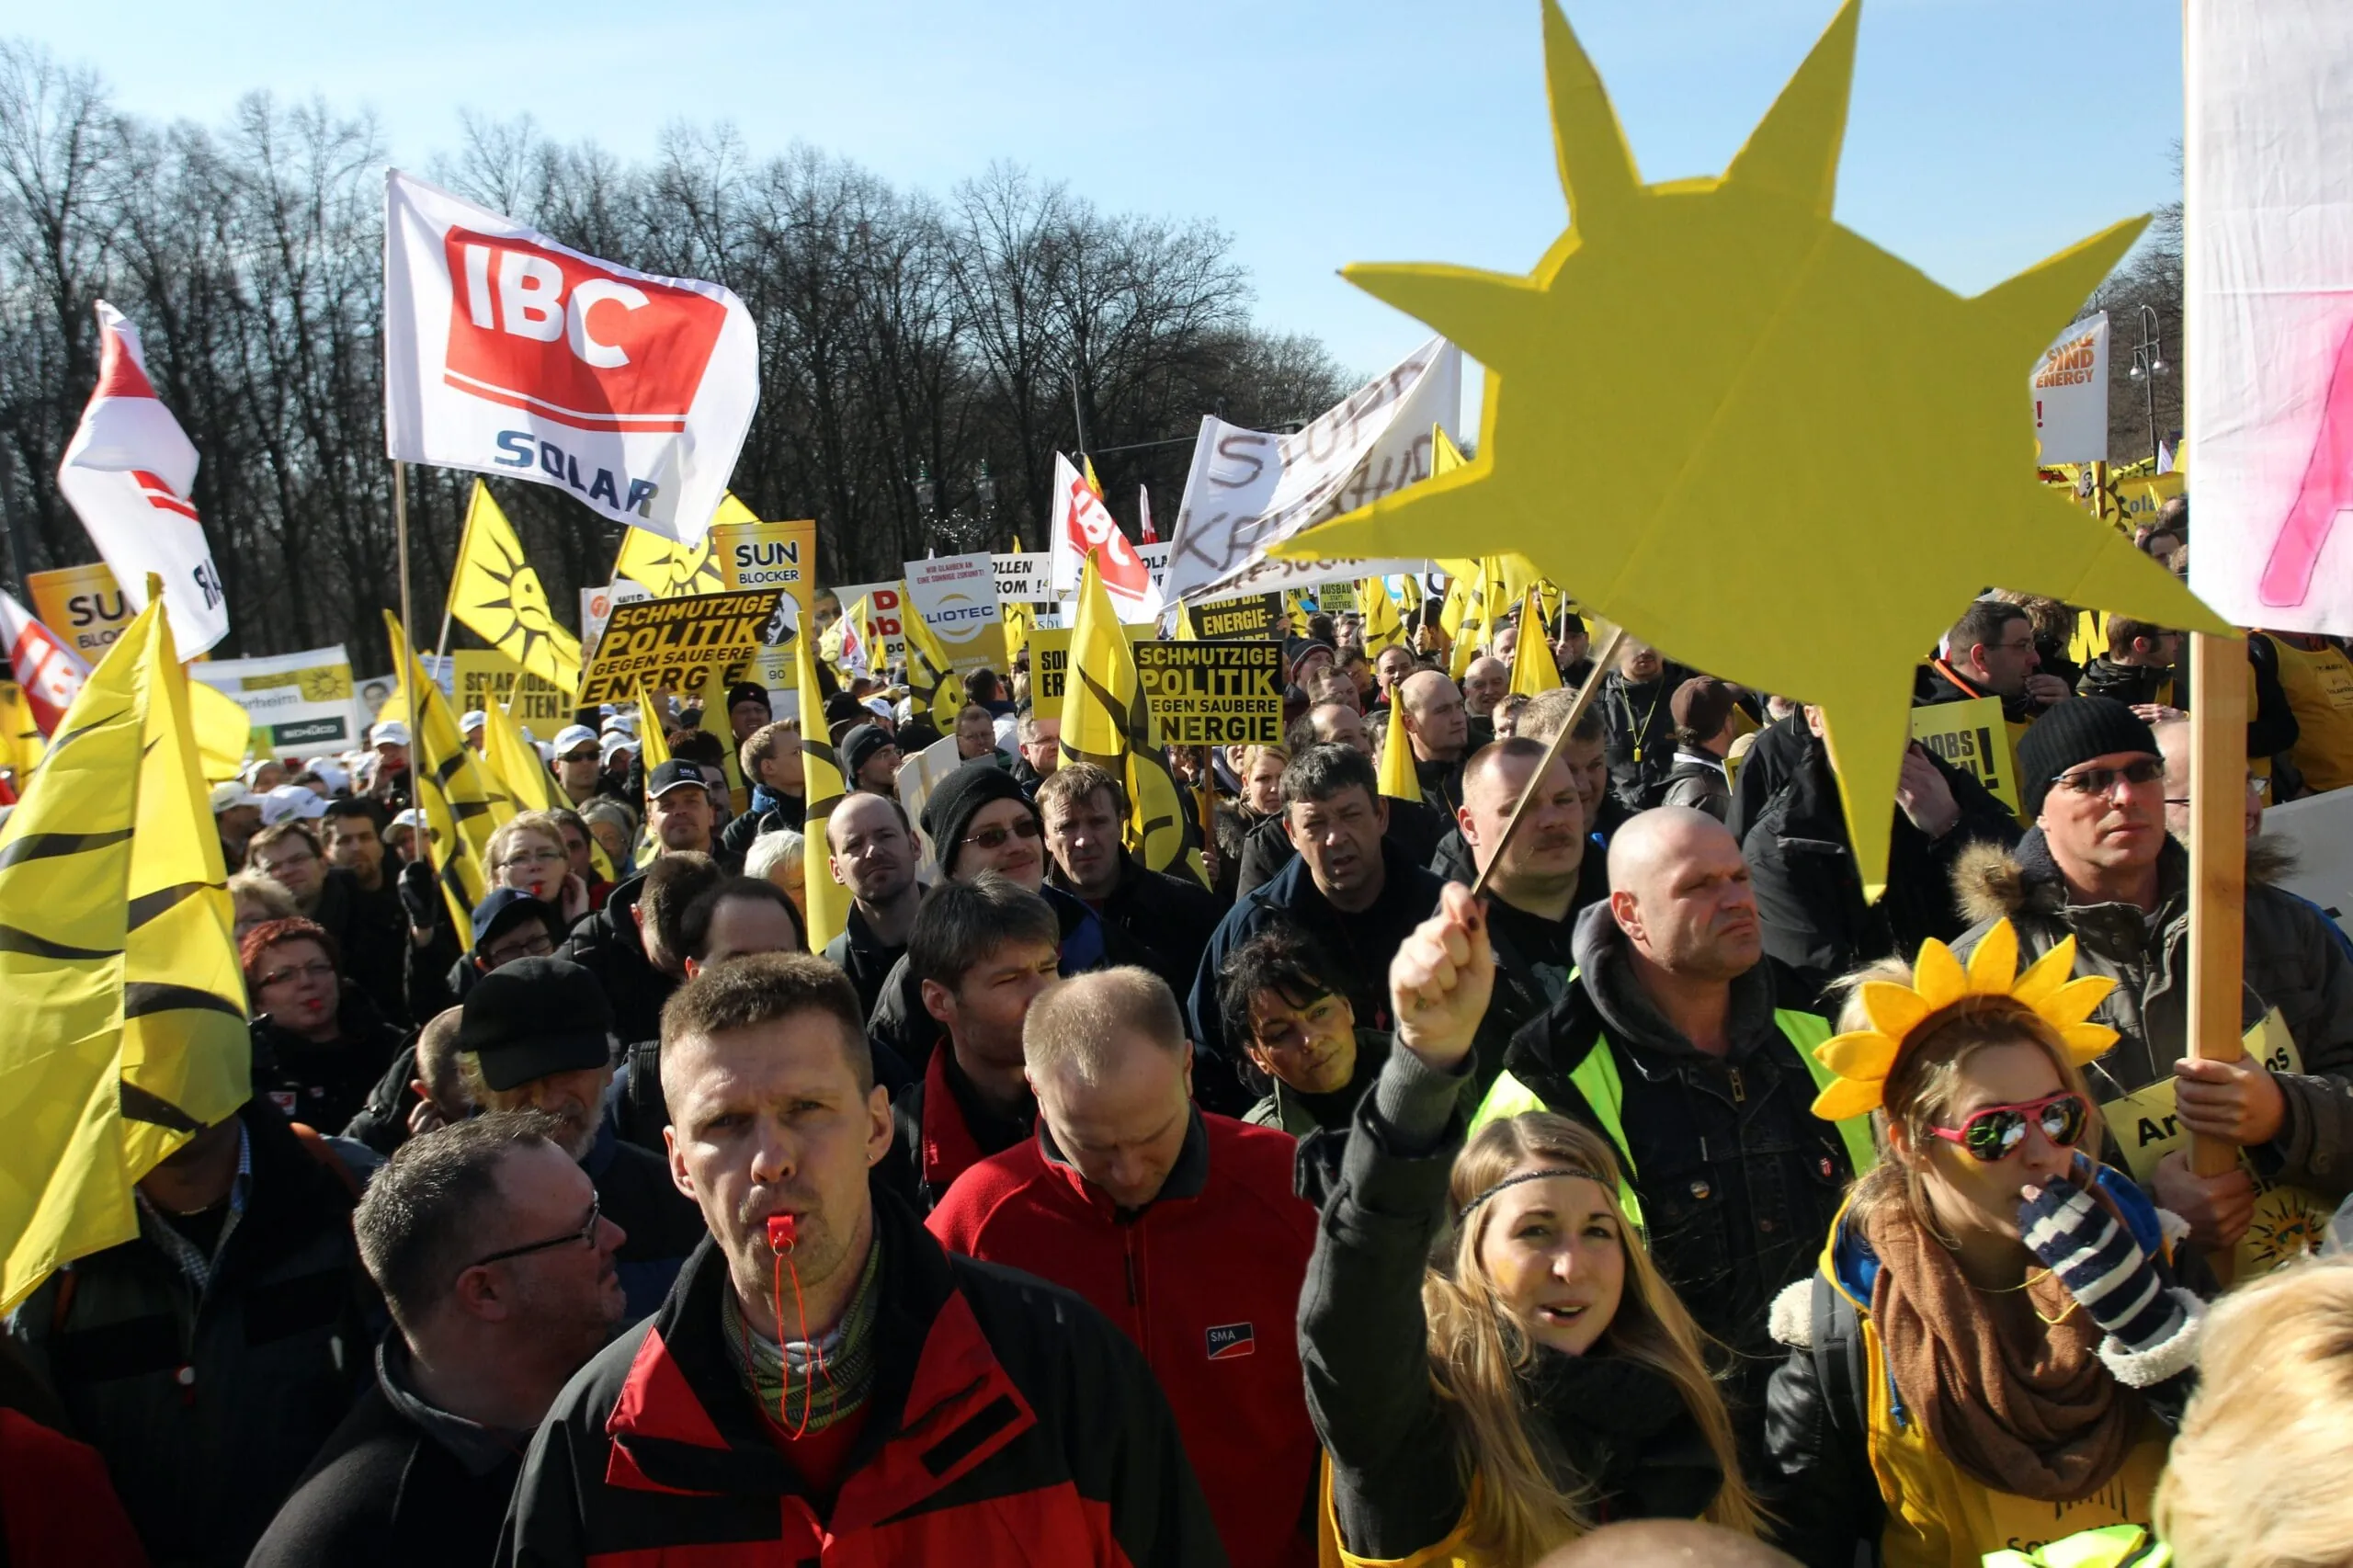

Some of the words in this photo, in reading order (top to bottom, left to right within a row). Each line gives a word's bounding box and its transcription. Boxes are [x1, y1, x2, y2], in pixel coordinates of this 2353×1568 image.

[464, 244, 650, 369] IBC
[2035, 369, 2094, 389] ENERGY
[494, 429, 659, 518] SOLAR
[735, 540, 799, 568] SUN
[739, 570, 799, 585] BLOCKER
[1321, 583, 1352, 595] AUSBAU
[69, 589, 137, 627] SU
[612, 595, 778, 630] SCHMUTZIGE
[1324, 600, 1352, 609] AUSSTIEG
[1202, 608, 1274, 636] ENERGIE-
[599, 616, 767, 660] POLITIK
[593, 653, 660, 676] GEGEN
[662, 646, 754, 665] SAUBERE
[1139, 647, 1278, 665] SCHMUTZIGE
[580, 662, 747, 704] ENERGE
[768, 669, 786, 680] 90
[1139, 668, 1277, 696] POLITIK
[1151, 699, 1195, 712] EGEN
[1199, 699, 1278, 712] SAUBERE
[1154, 716, 1278, 742] NERGIE
[1210, 1330, 1236, 1342] SMA
